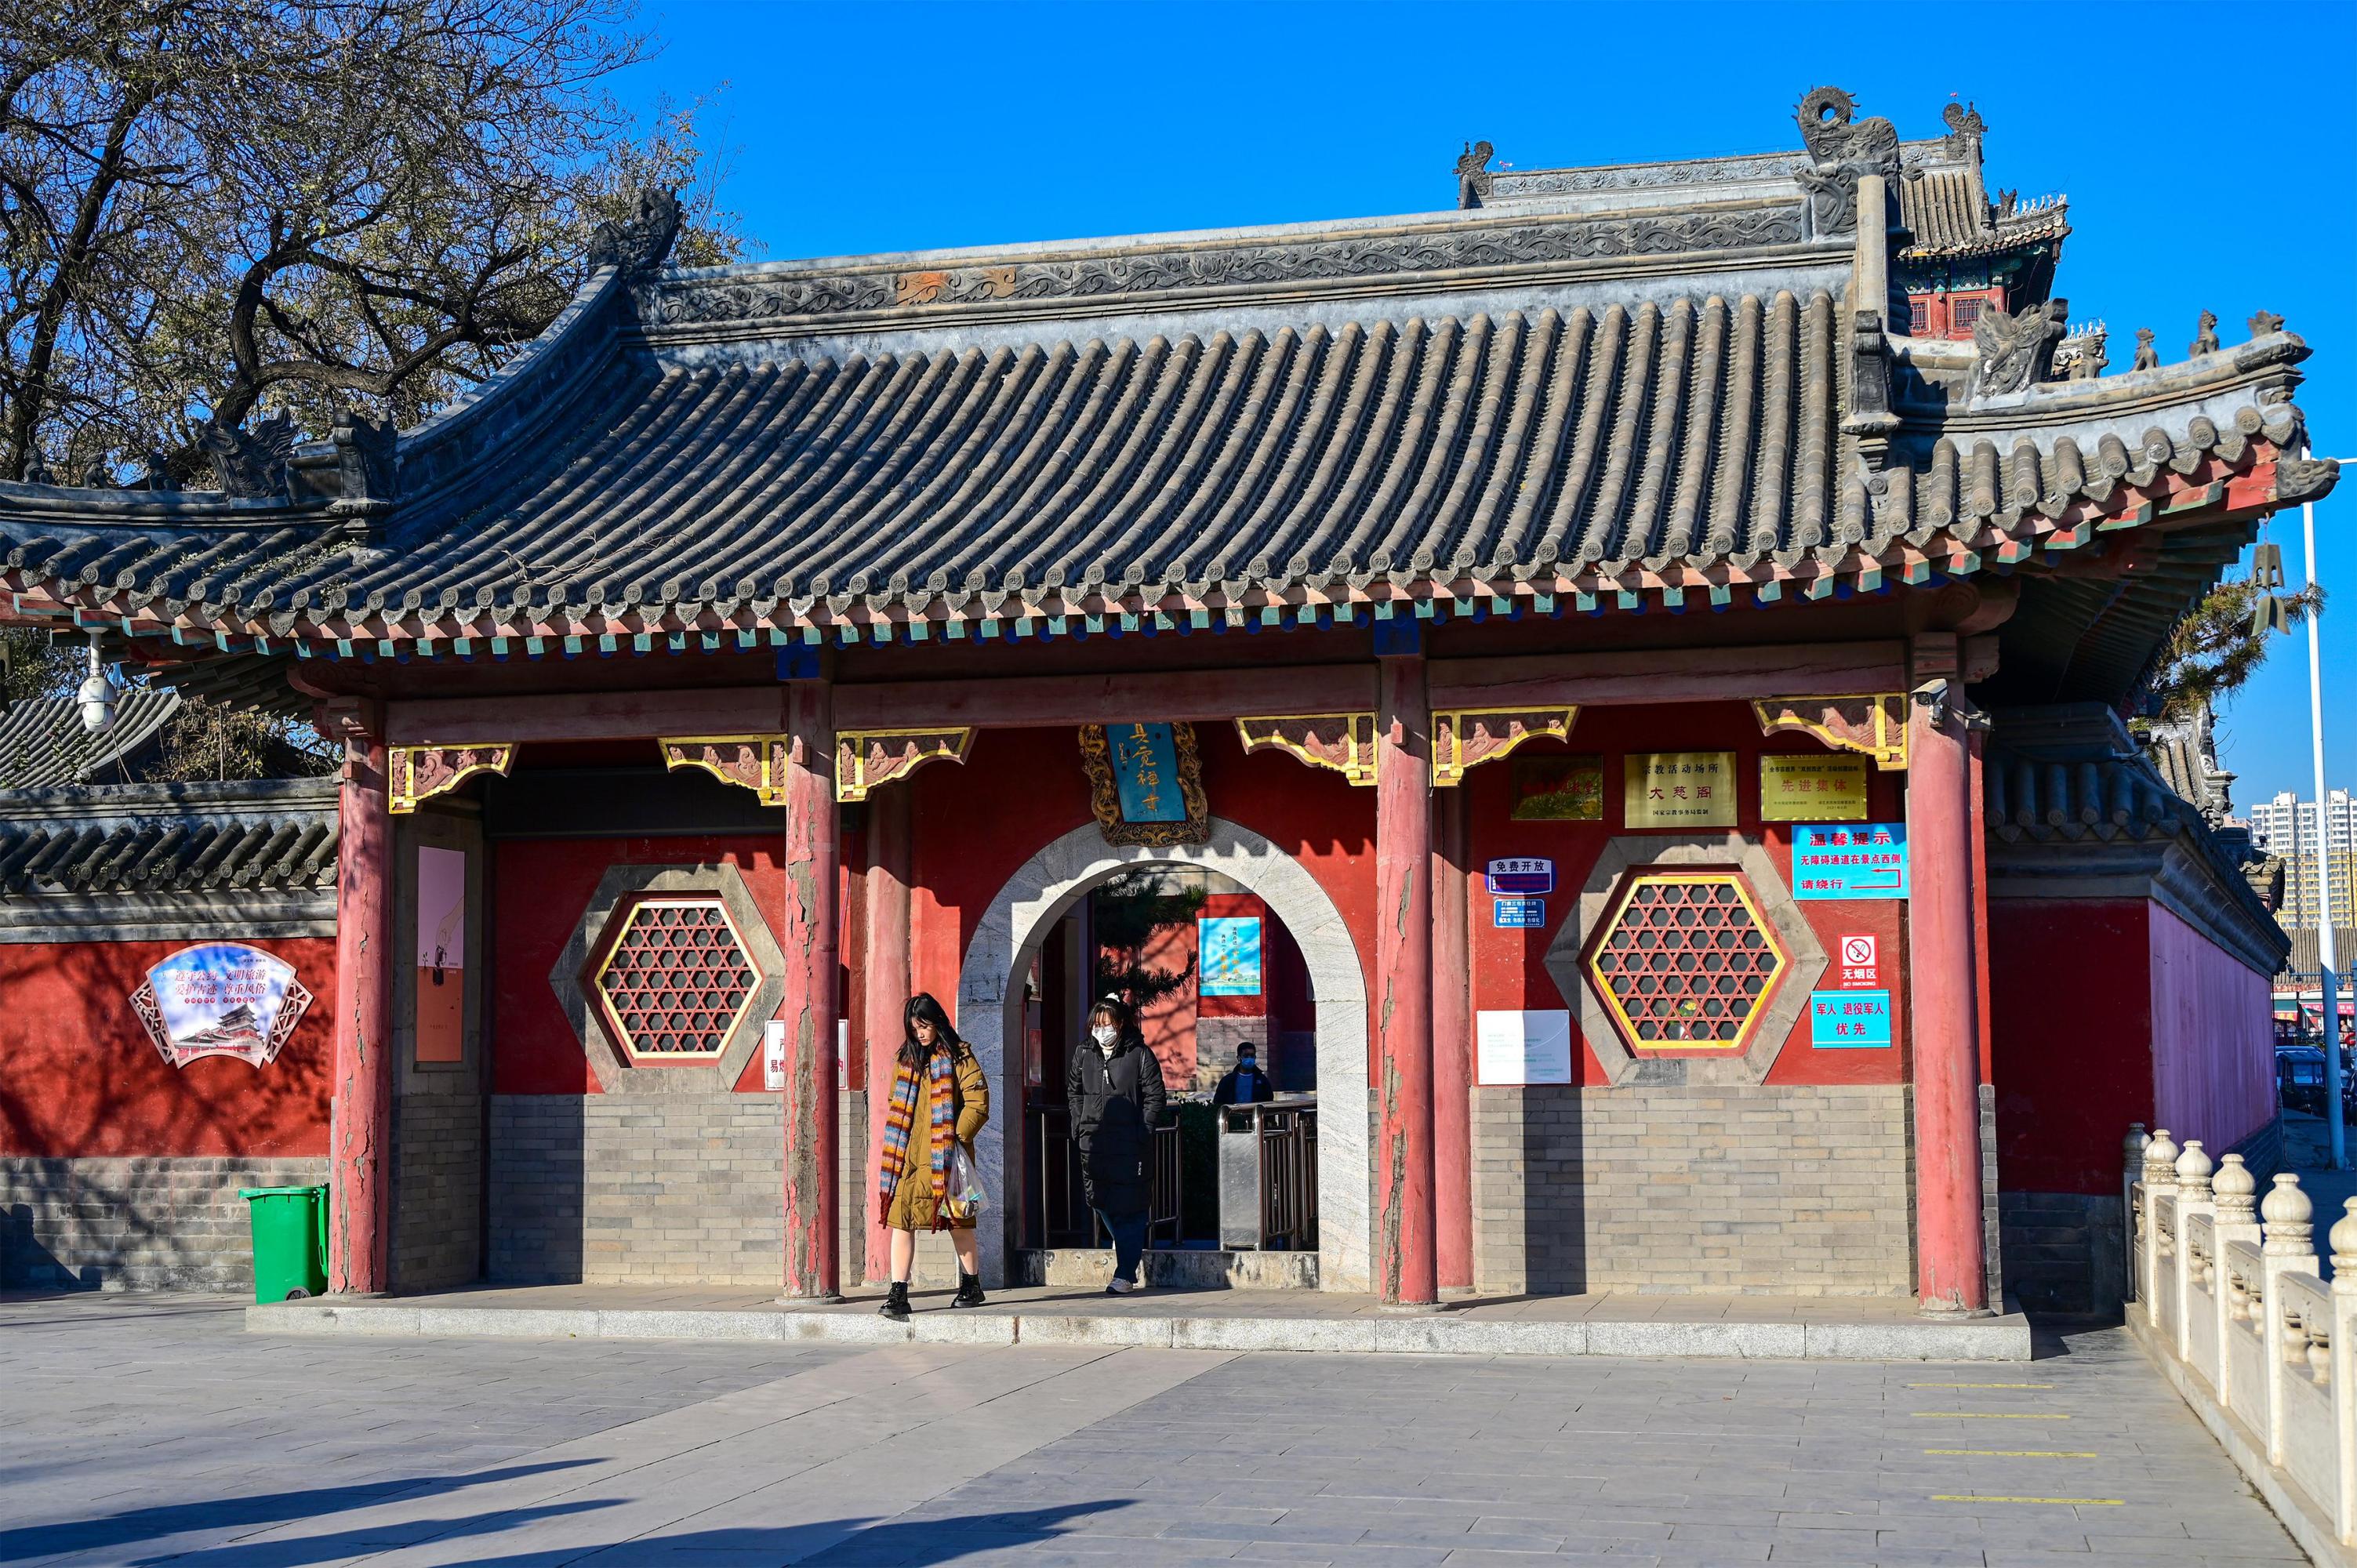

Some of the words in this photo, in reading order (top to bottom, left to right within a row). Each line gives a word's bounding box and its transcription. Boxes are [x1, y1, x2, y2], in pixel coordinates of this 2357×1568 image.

[1642, 764, 1719, 775] 宗教活动场所
[1781, 779, 1847, 792] 先进集体
[1649, 786, 1712, 800] 大慈阁
[1810, 832, 1890, 846] 温馨提示
[1800, 854, 1901, 866] 无障碍通道在景点西侧
[1496, 861, 1545, 872] 免费开放
[1801, 879, 1843, 890] 请绕行
[176, 971, 217, 981] 遵守公约
[225, 969, 266, 980] 文明旅游
[1843, 968, 1876, 979] 无烟区
[176, 983, 217, 995] 爱护古迹
[224, 982, 266, 994] 尊重风俗
[1817, 1004, 1836, 1015] 军人
[1843, 1003, 1884, 1015] 退役军人
[1836, 1022, 1866, 1036] 优先
